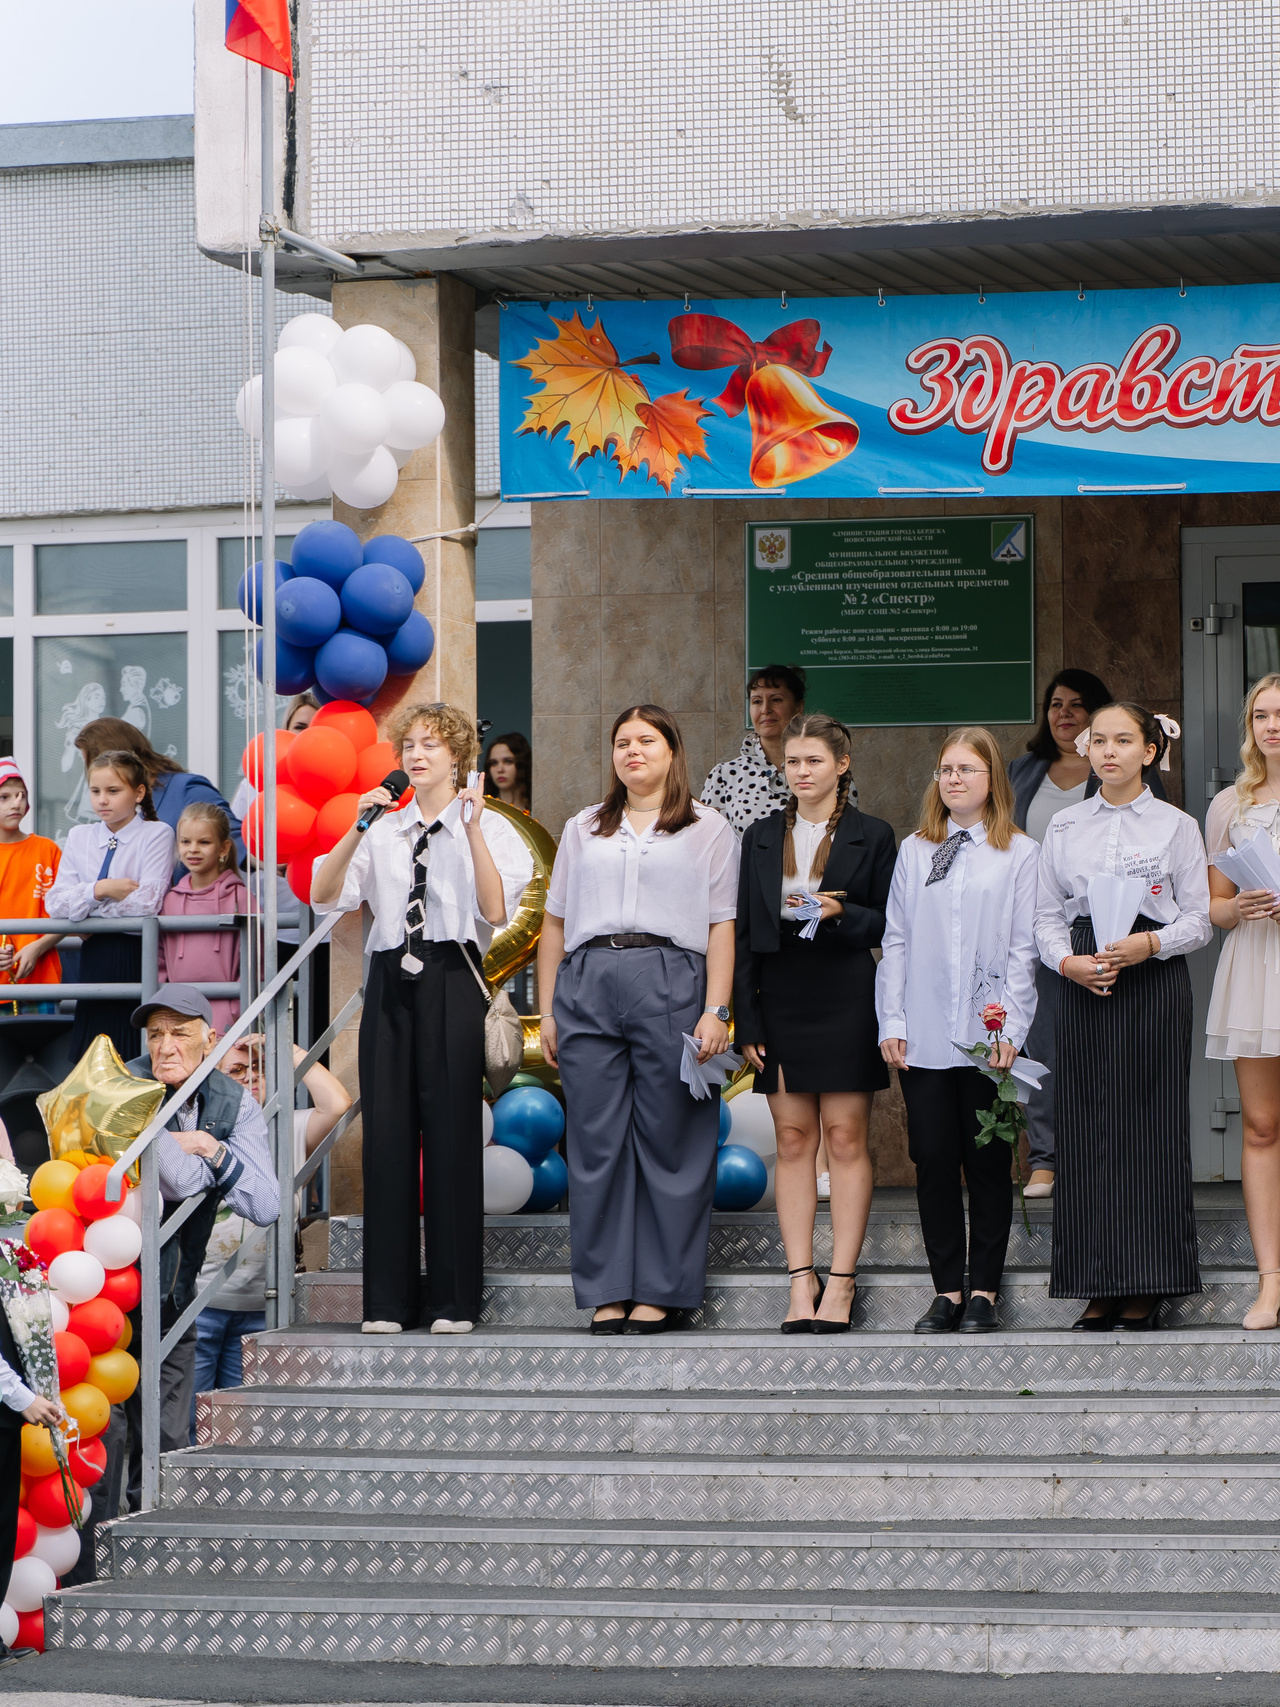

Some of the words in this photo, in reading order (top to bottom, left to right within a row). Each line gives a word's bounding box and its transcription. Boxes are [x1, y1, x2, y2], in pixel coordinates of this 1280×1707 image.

[829, 550, 898, 558] МУНИЦИПАЛЬНОЕ
[900, 549, 949, 557] БЮДЖЕТНОЕ
[815, 559, 908, 568] ОБЩЕОБРАЗОВАТЕЛЬНОЕ
[909, 558, 962, 566] УЧРЕЖДЕНИЕ
[792, 571, 839, 582] «Средняя
[842, 569, 951, 580] общеобразовательная
[954, 568, 986, 577] школа
[776, 582, 843, 594] углубленным
[845, 581, 898, 592] изучением
[900, 580, 954, 589] отдельных
[957, 579, 1009, 589] предметов
[842, 594, 857, 605] №
[860, 593, 868, 604] 2
[871, 592, 935, 606] «Спектр»
[841, 609, 865, 617] (МБОУ
[902, 607, 937, 615] «Спектр»)
[824, 628, 851, 636] работы:
[811, 636, 836, 644] суббота
